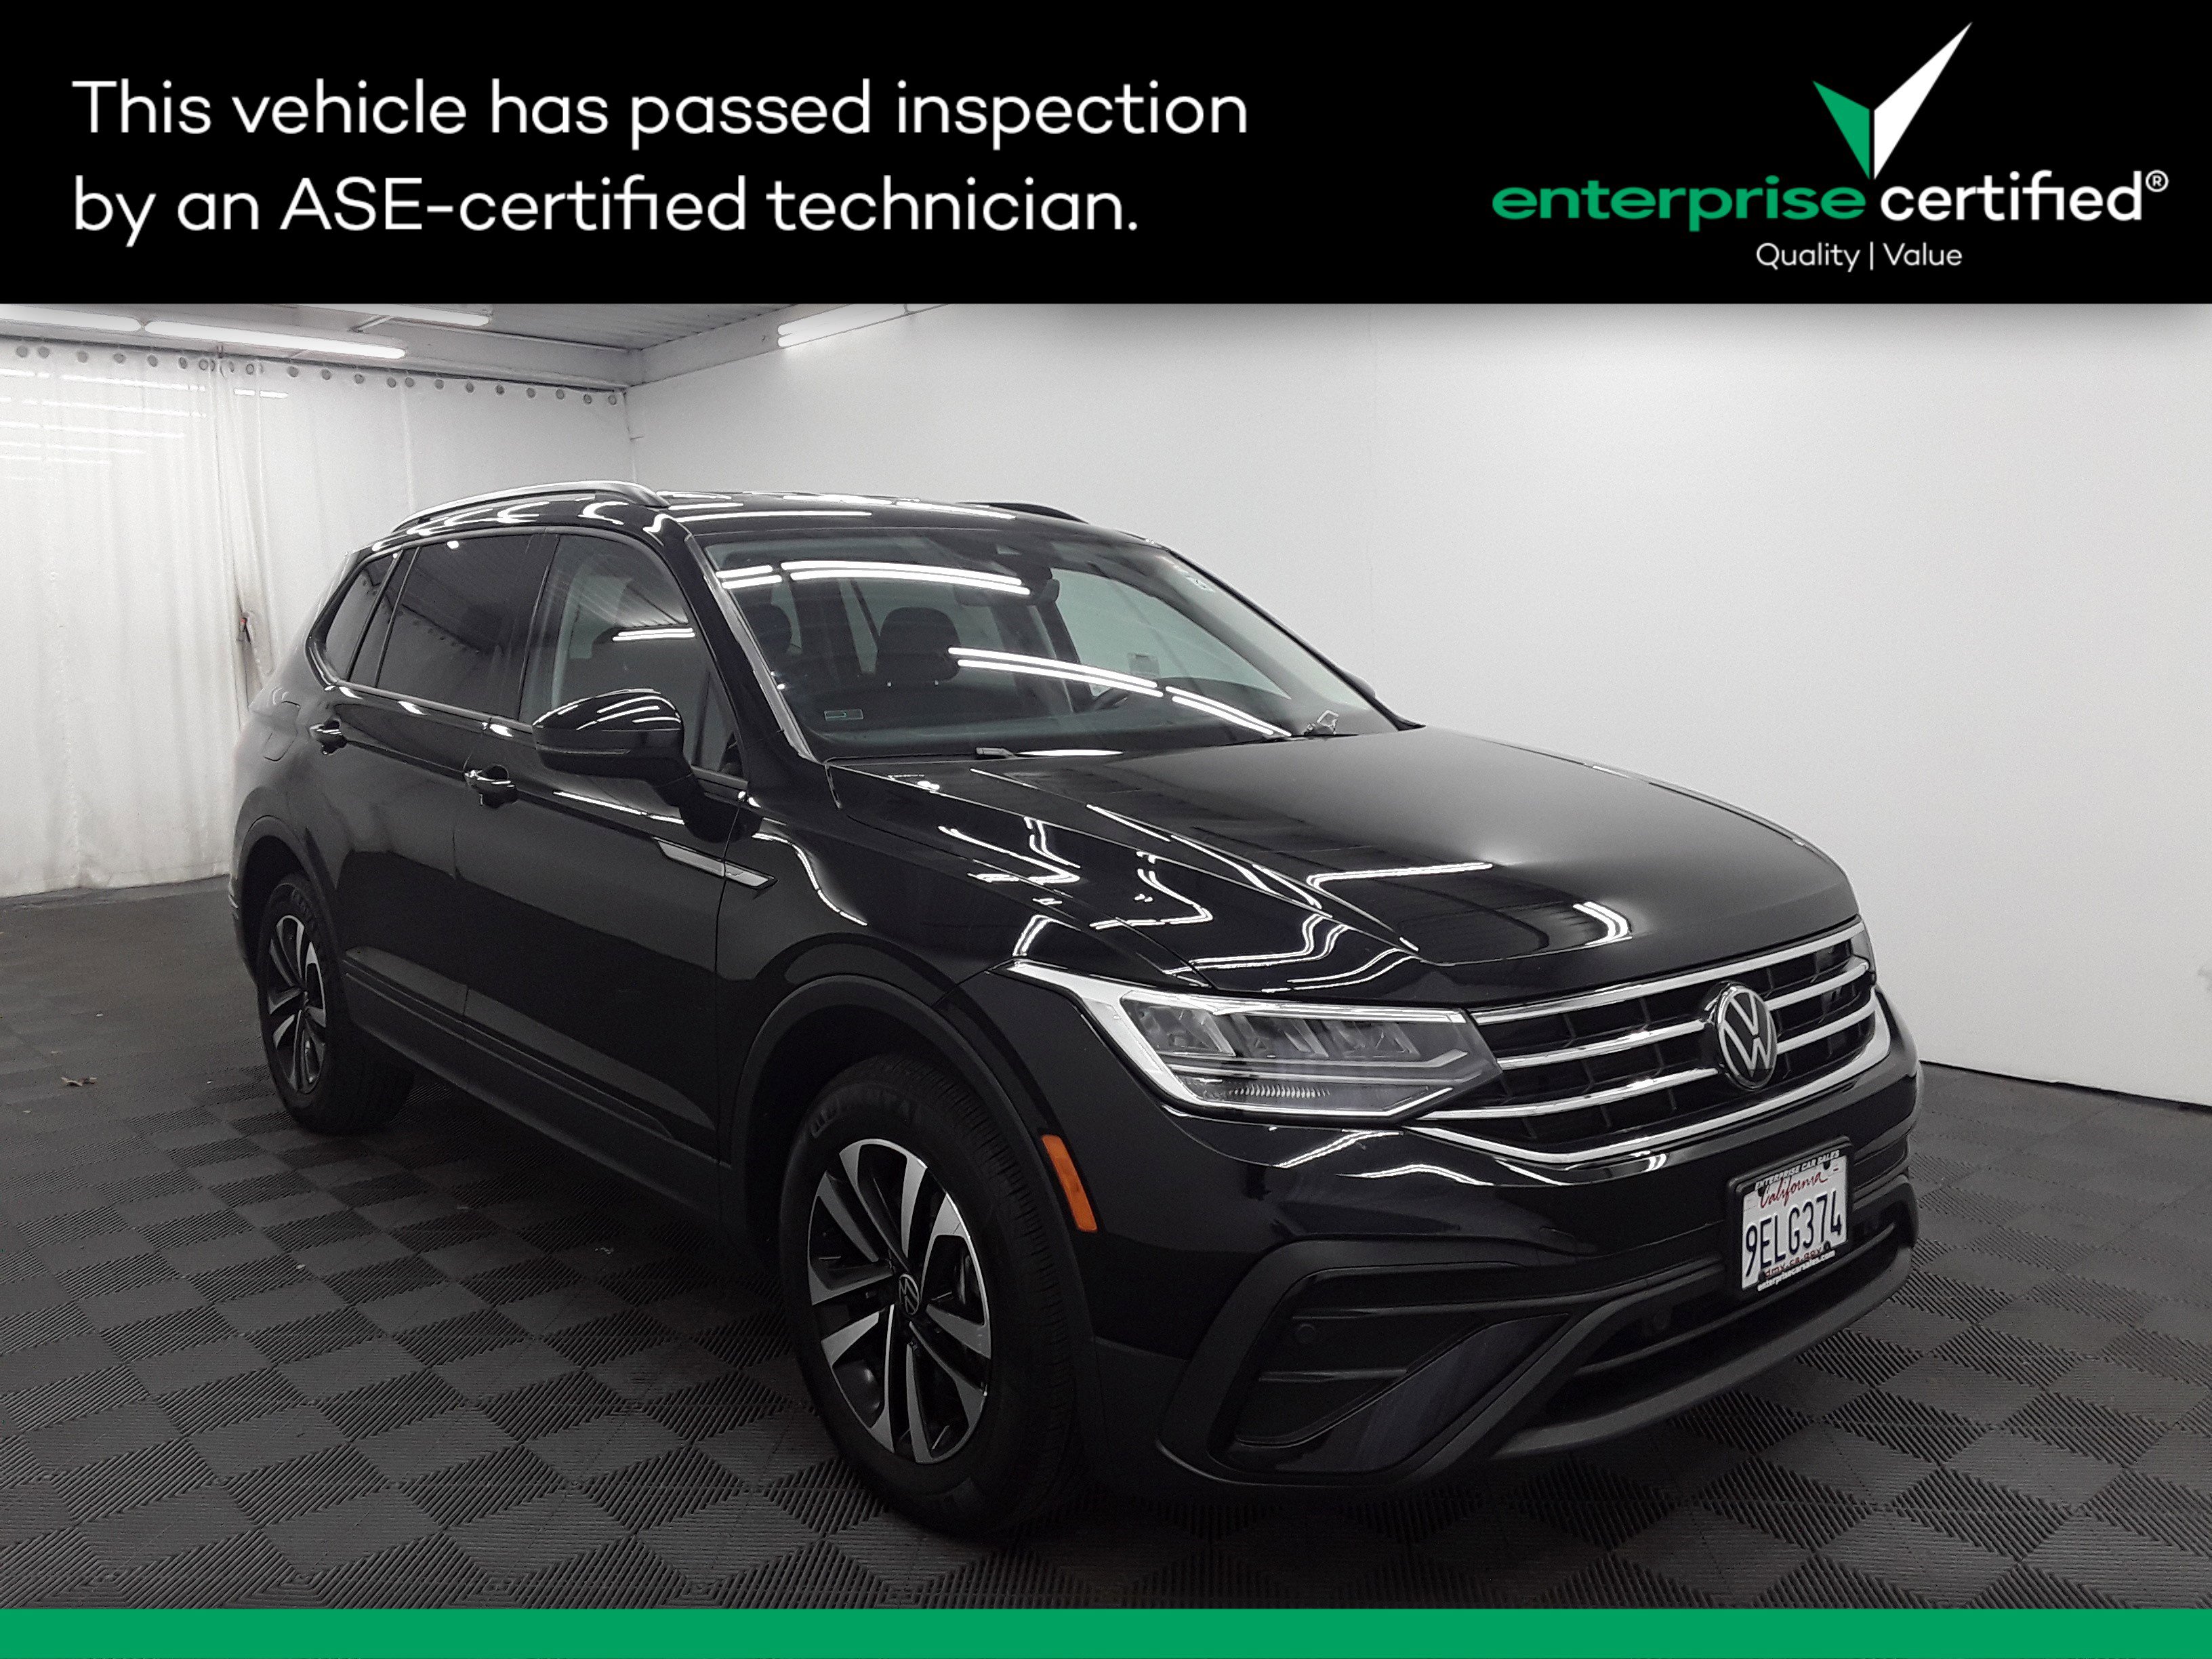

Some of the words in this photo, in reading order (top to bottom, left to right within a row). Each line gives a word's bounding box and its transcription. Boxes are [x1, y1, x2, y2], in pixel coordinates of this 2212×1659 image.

[1801, 1159, 1816, 1171] CAR
[1817, 1150, 1839, 1165] SALES
[1761, 1172, 1828, 1208] California
[1745, 1189, 1842, 1277] 9ELG374
